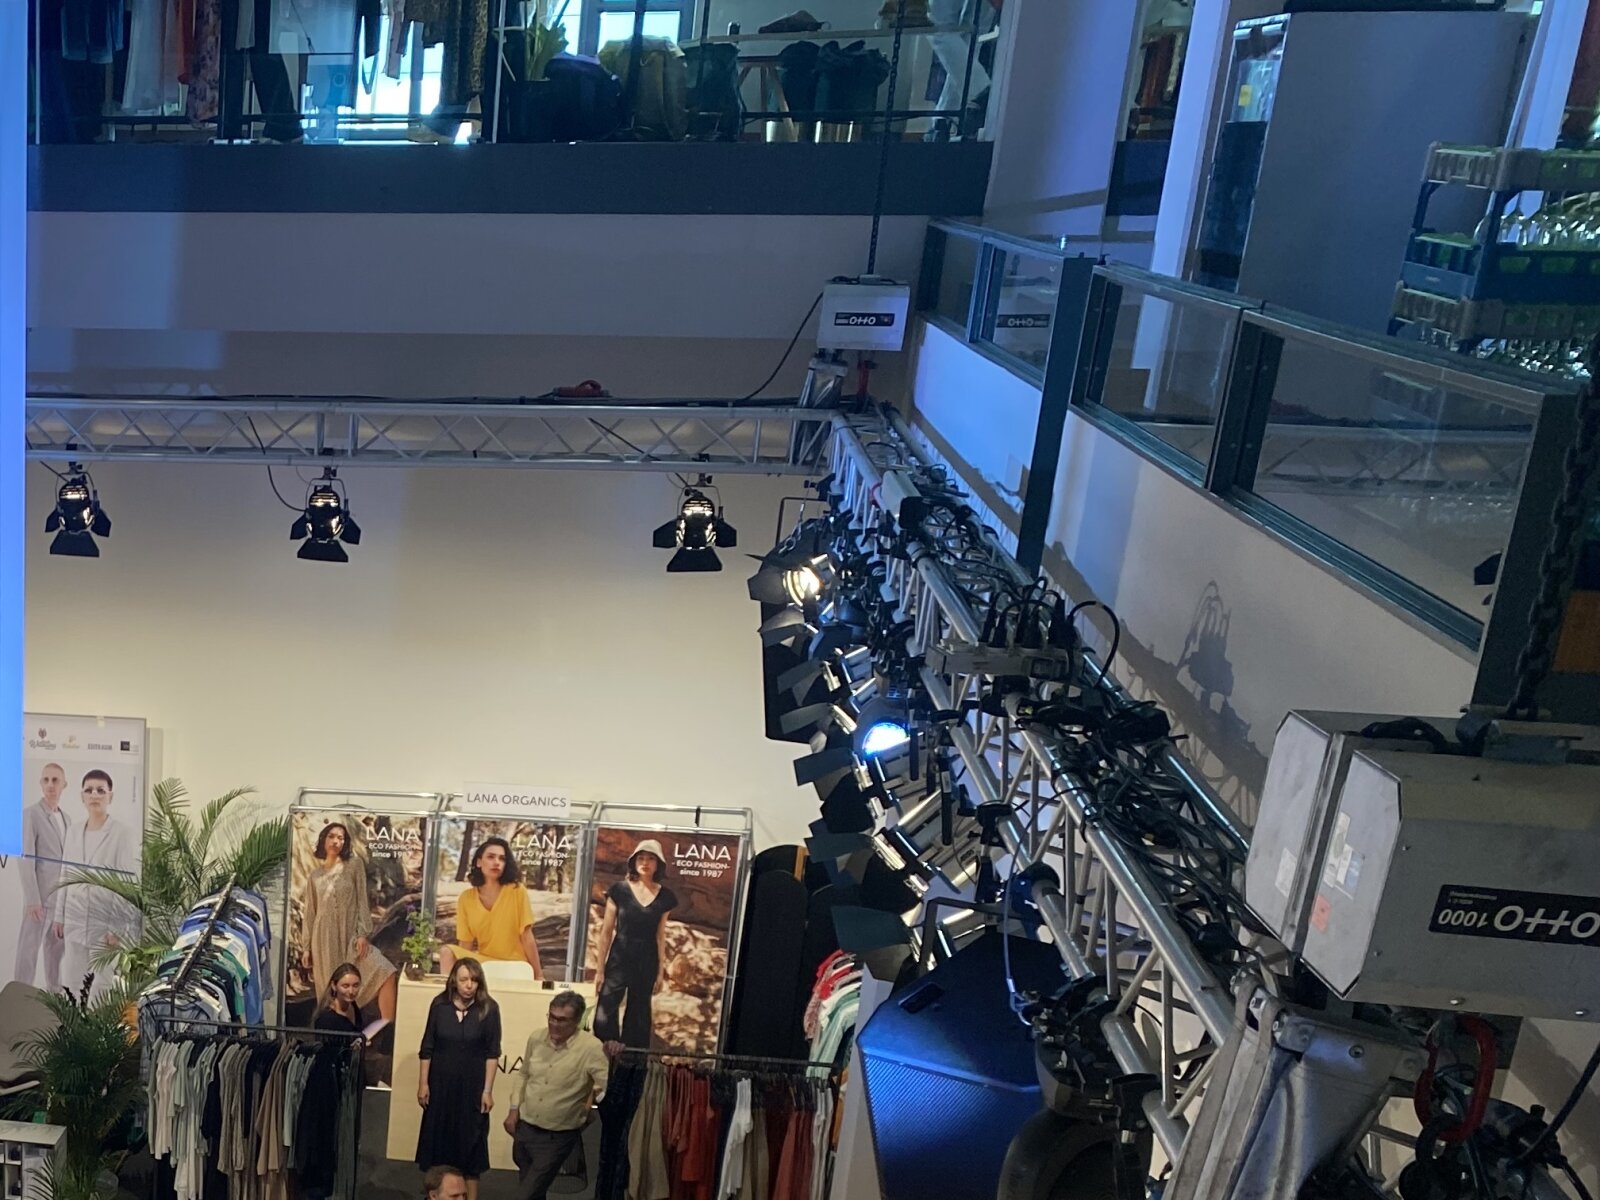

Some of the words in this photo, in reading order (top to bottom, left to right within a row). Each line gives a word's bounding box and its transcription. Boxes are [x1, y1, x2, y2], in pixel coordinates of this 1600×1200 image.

[467, 793, 499, 805] LANA
[501, 794, 567, 808] ORGANICS
[366, 826, 420, 842] LANA
[516, 834, 571, 851] LANA
[372, 851, 391, 859] since
[674, 843, 732, 861] LANA
[521, 858, 541, 866] since
[543, 859, 564, 868] 1987
[680, 868, 700, 876] since
[703, 869, 723, 878] 1987
[1437, 908, 1489, 928] 1000
[1493, 905, 1600, 938] OTTO
